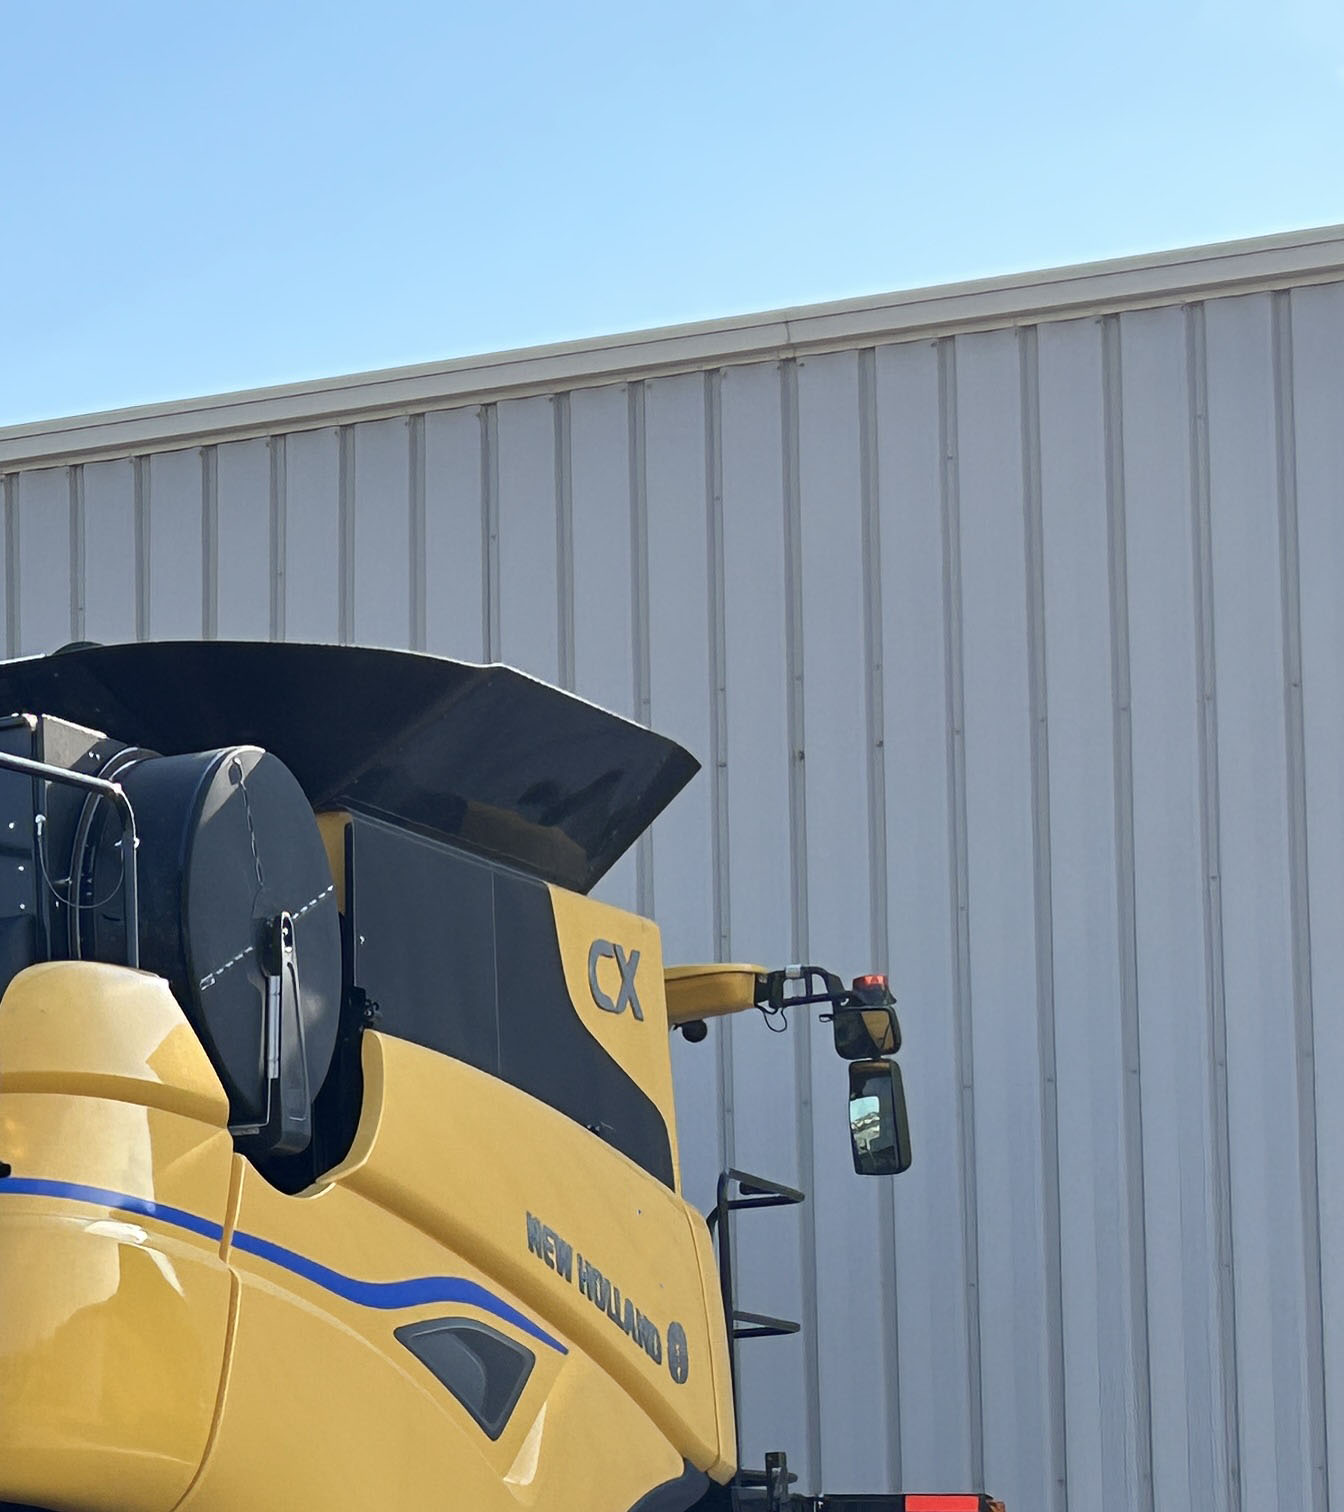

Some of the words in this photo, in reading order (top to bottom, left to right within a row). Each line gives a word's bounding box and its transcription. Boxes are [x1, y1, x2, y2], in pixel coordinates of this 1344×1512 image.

[588, 938, 644, 1022] CX
[526, 1210, 573, 1284] NEW
[576, 1252, 662, 1366] HOLLAND
